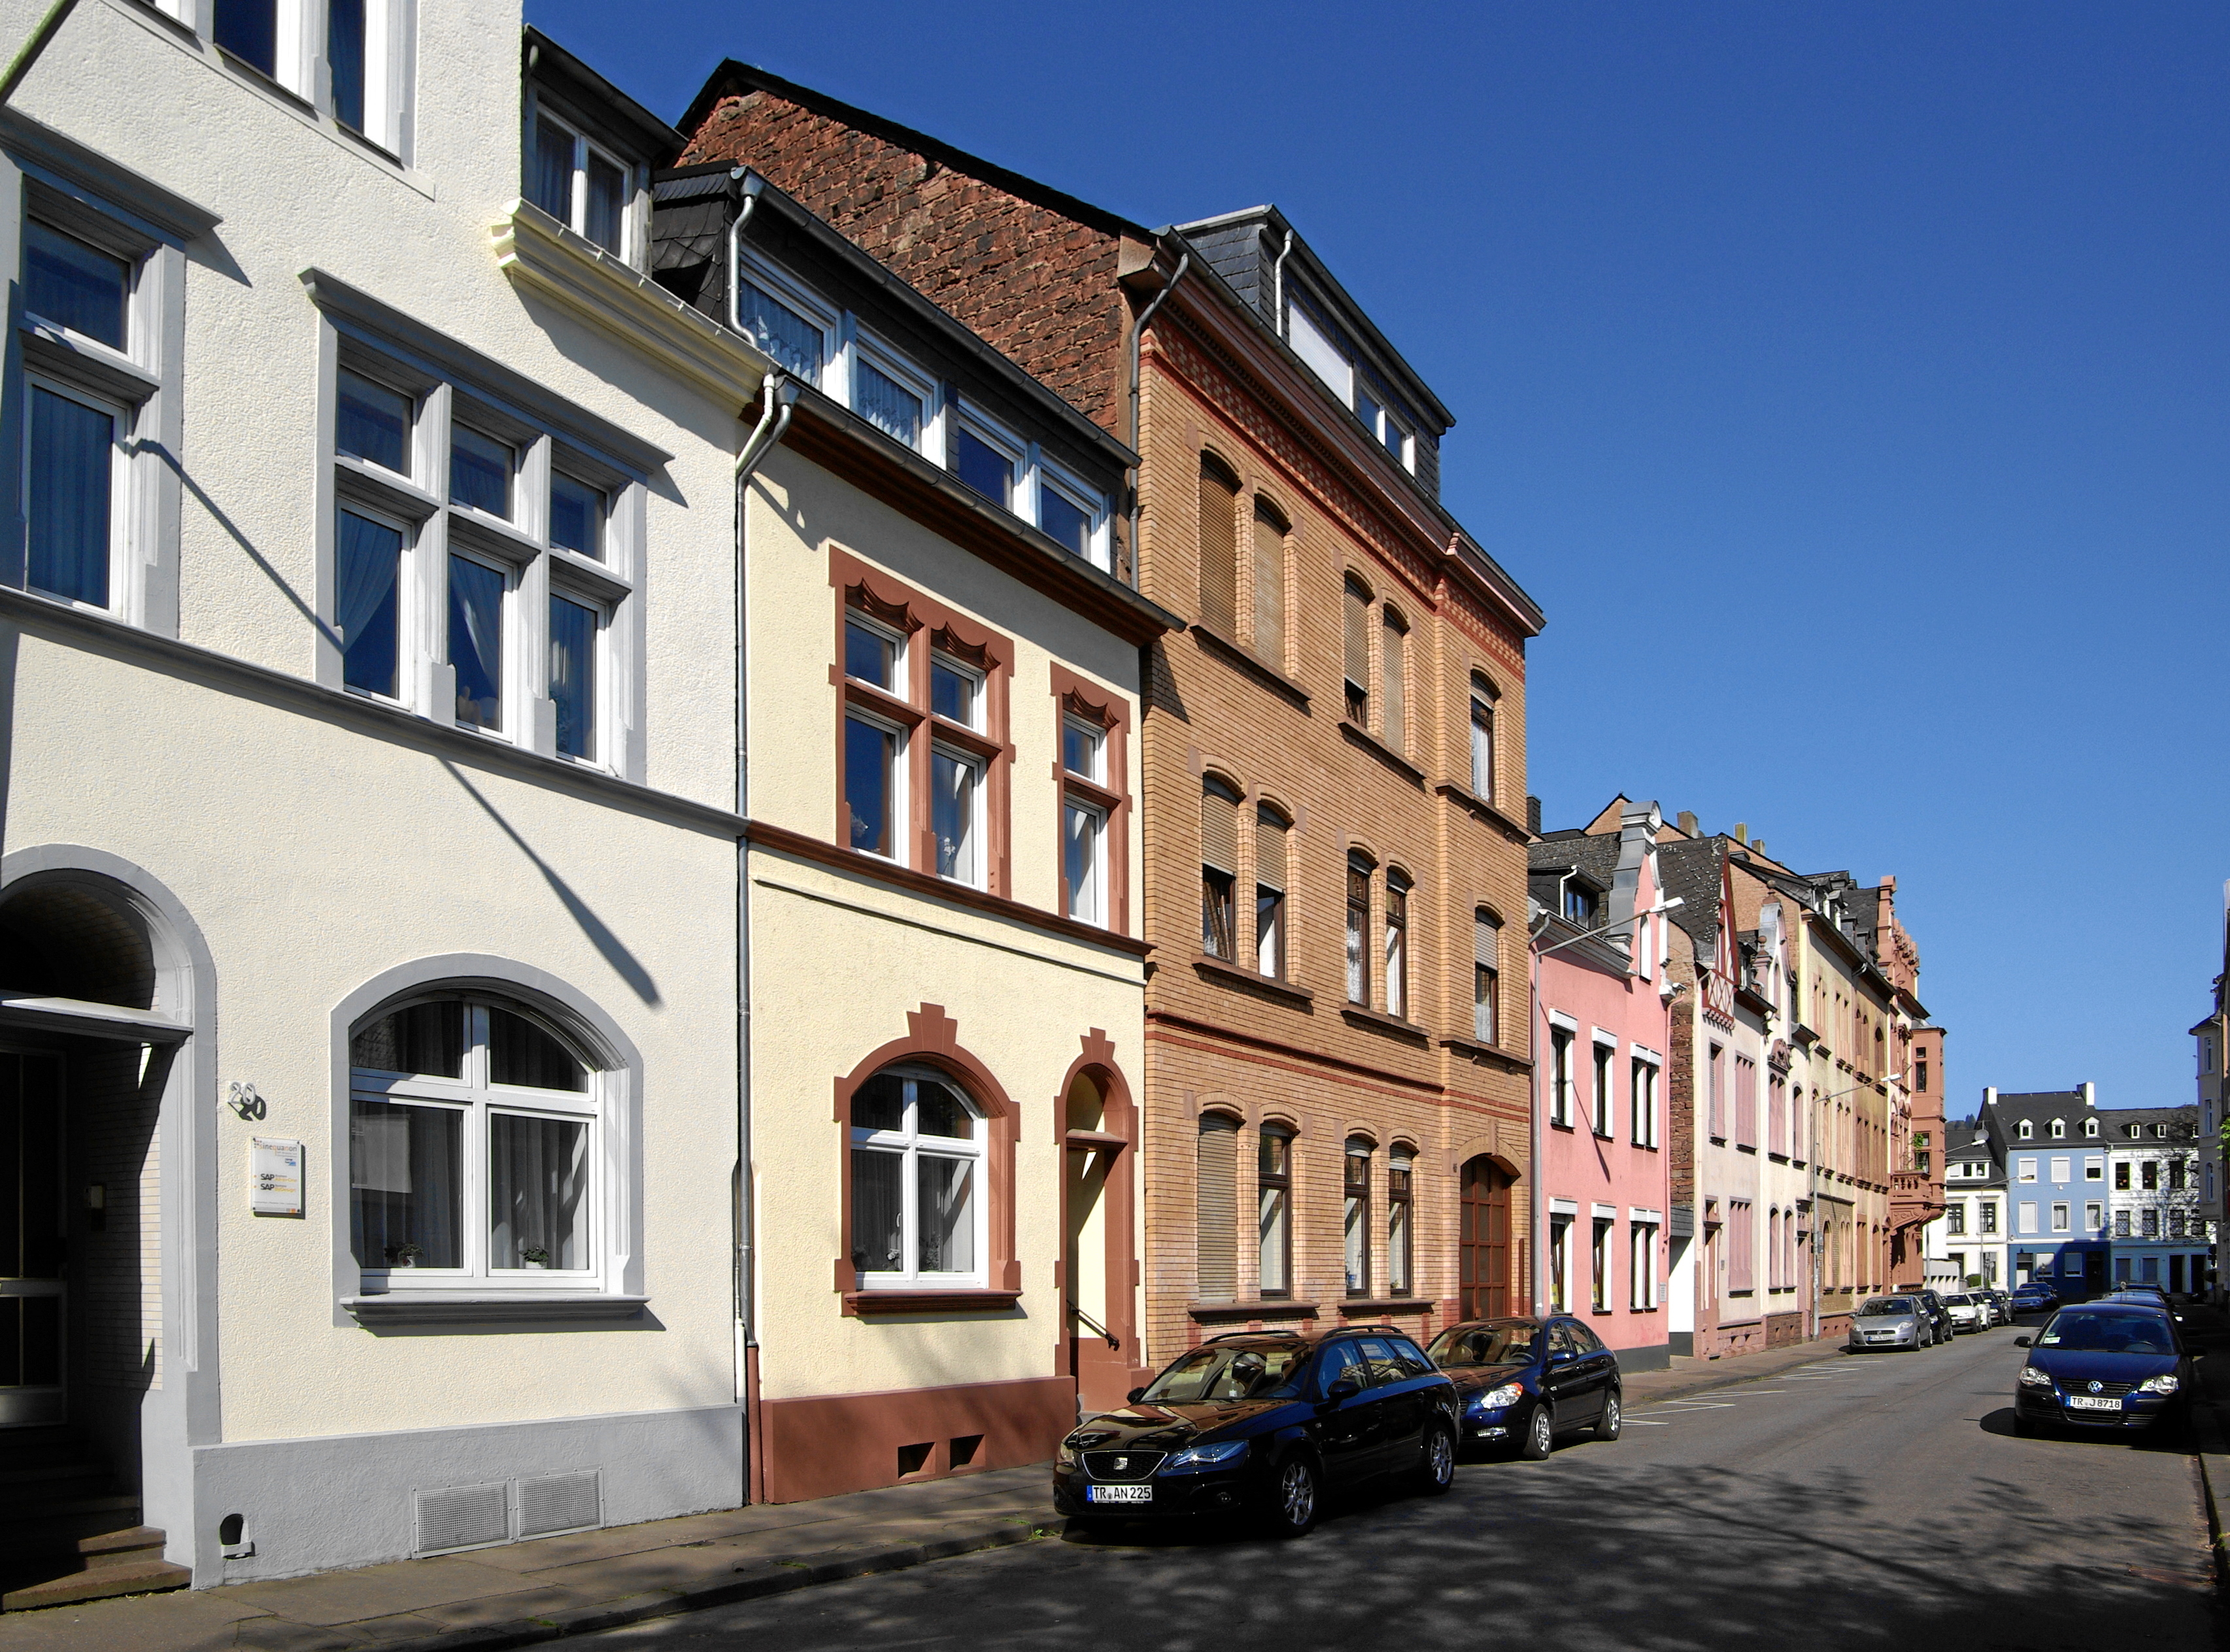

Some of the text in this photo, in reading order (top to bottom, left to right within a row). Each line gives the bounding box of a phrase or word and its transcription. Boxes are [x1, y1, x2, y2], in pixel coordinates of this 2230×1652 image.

[228, 1081, 256, 1105] 20
[2097, 1400, 2120, 1408] 8718
[1094, 1487, 1151, 1498] TR AN 225
